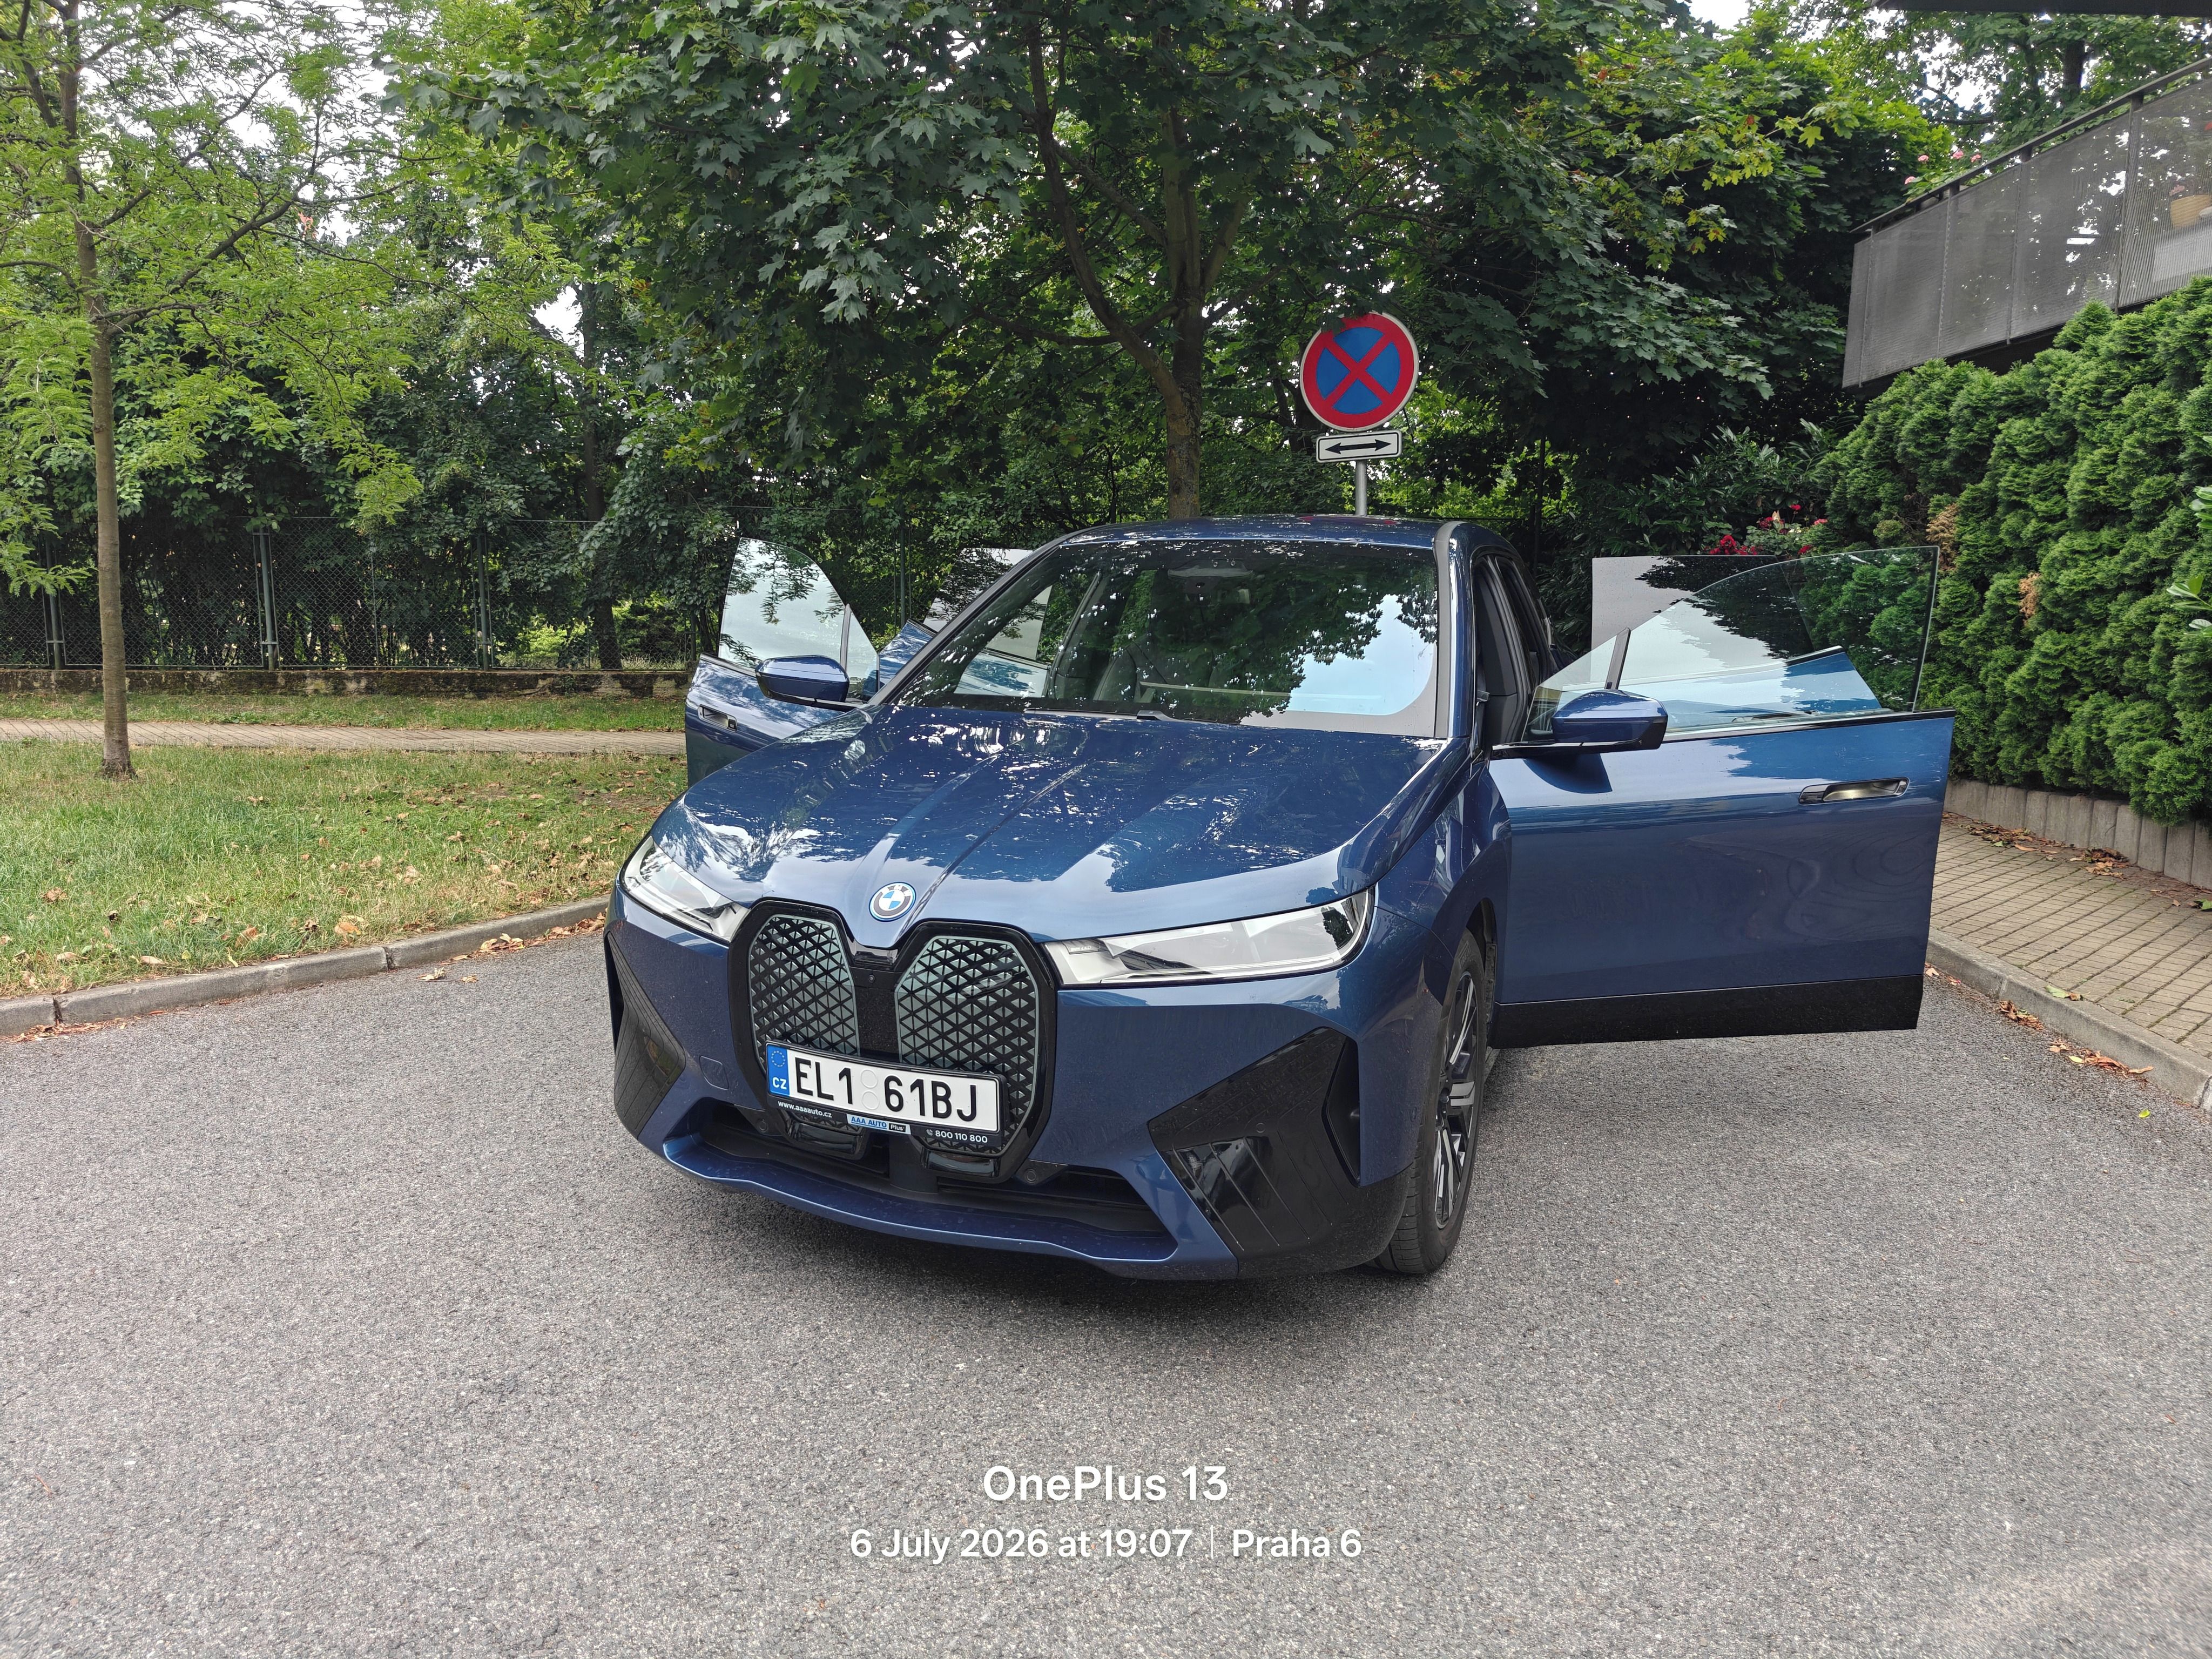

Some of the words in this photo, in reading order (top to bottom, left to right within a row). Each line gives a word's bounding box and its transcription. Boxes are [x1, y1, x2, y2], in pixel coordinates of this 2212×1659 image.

[881, 885, 911, 896] MW
[772, 1077, 787, 1090] CZ
[795, 1057, 853, 1105] EL1
[885, 1075, 976, 1122] 61BJ
[778, 1101, 832, 1118] www.aaaauto.cz
[851, 1116, 866, 1124] AAA
[868, 1119, 887, 1128] AUTO
[935, 1130, 953, 1138] 800
[954, 1132, 968, 1141] 110
[969, 1135, 988, 1143] 800
